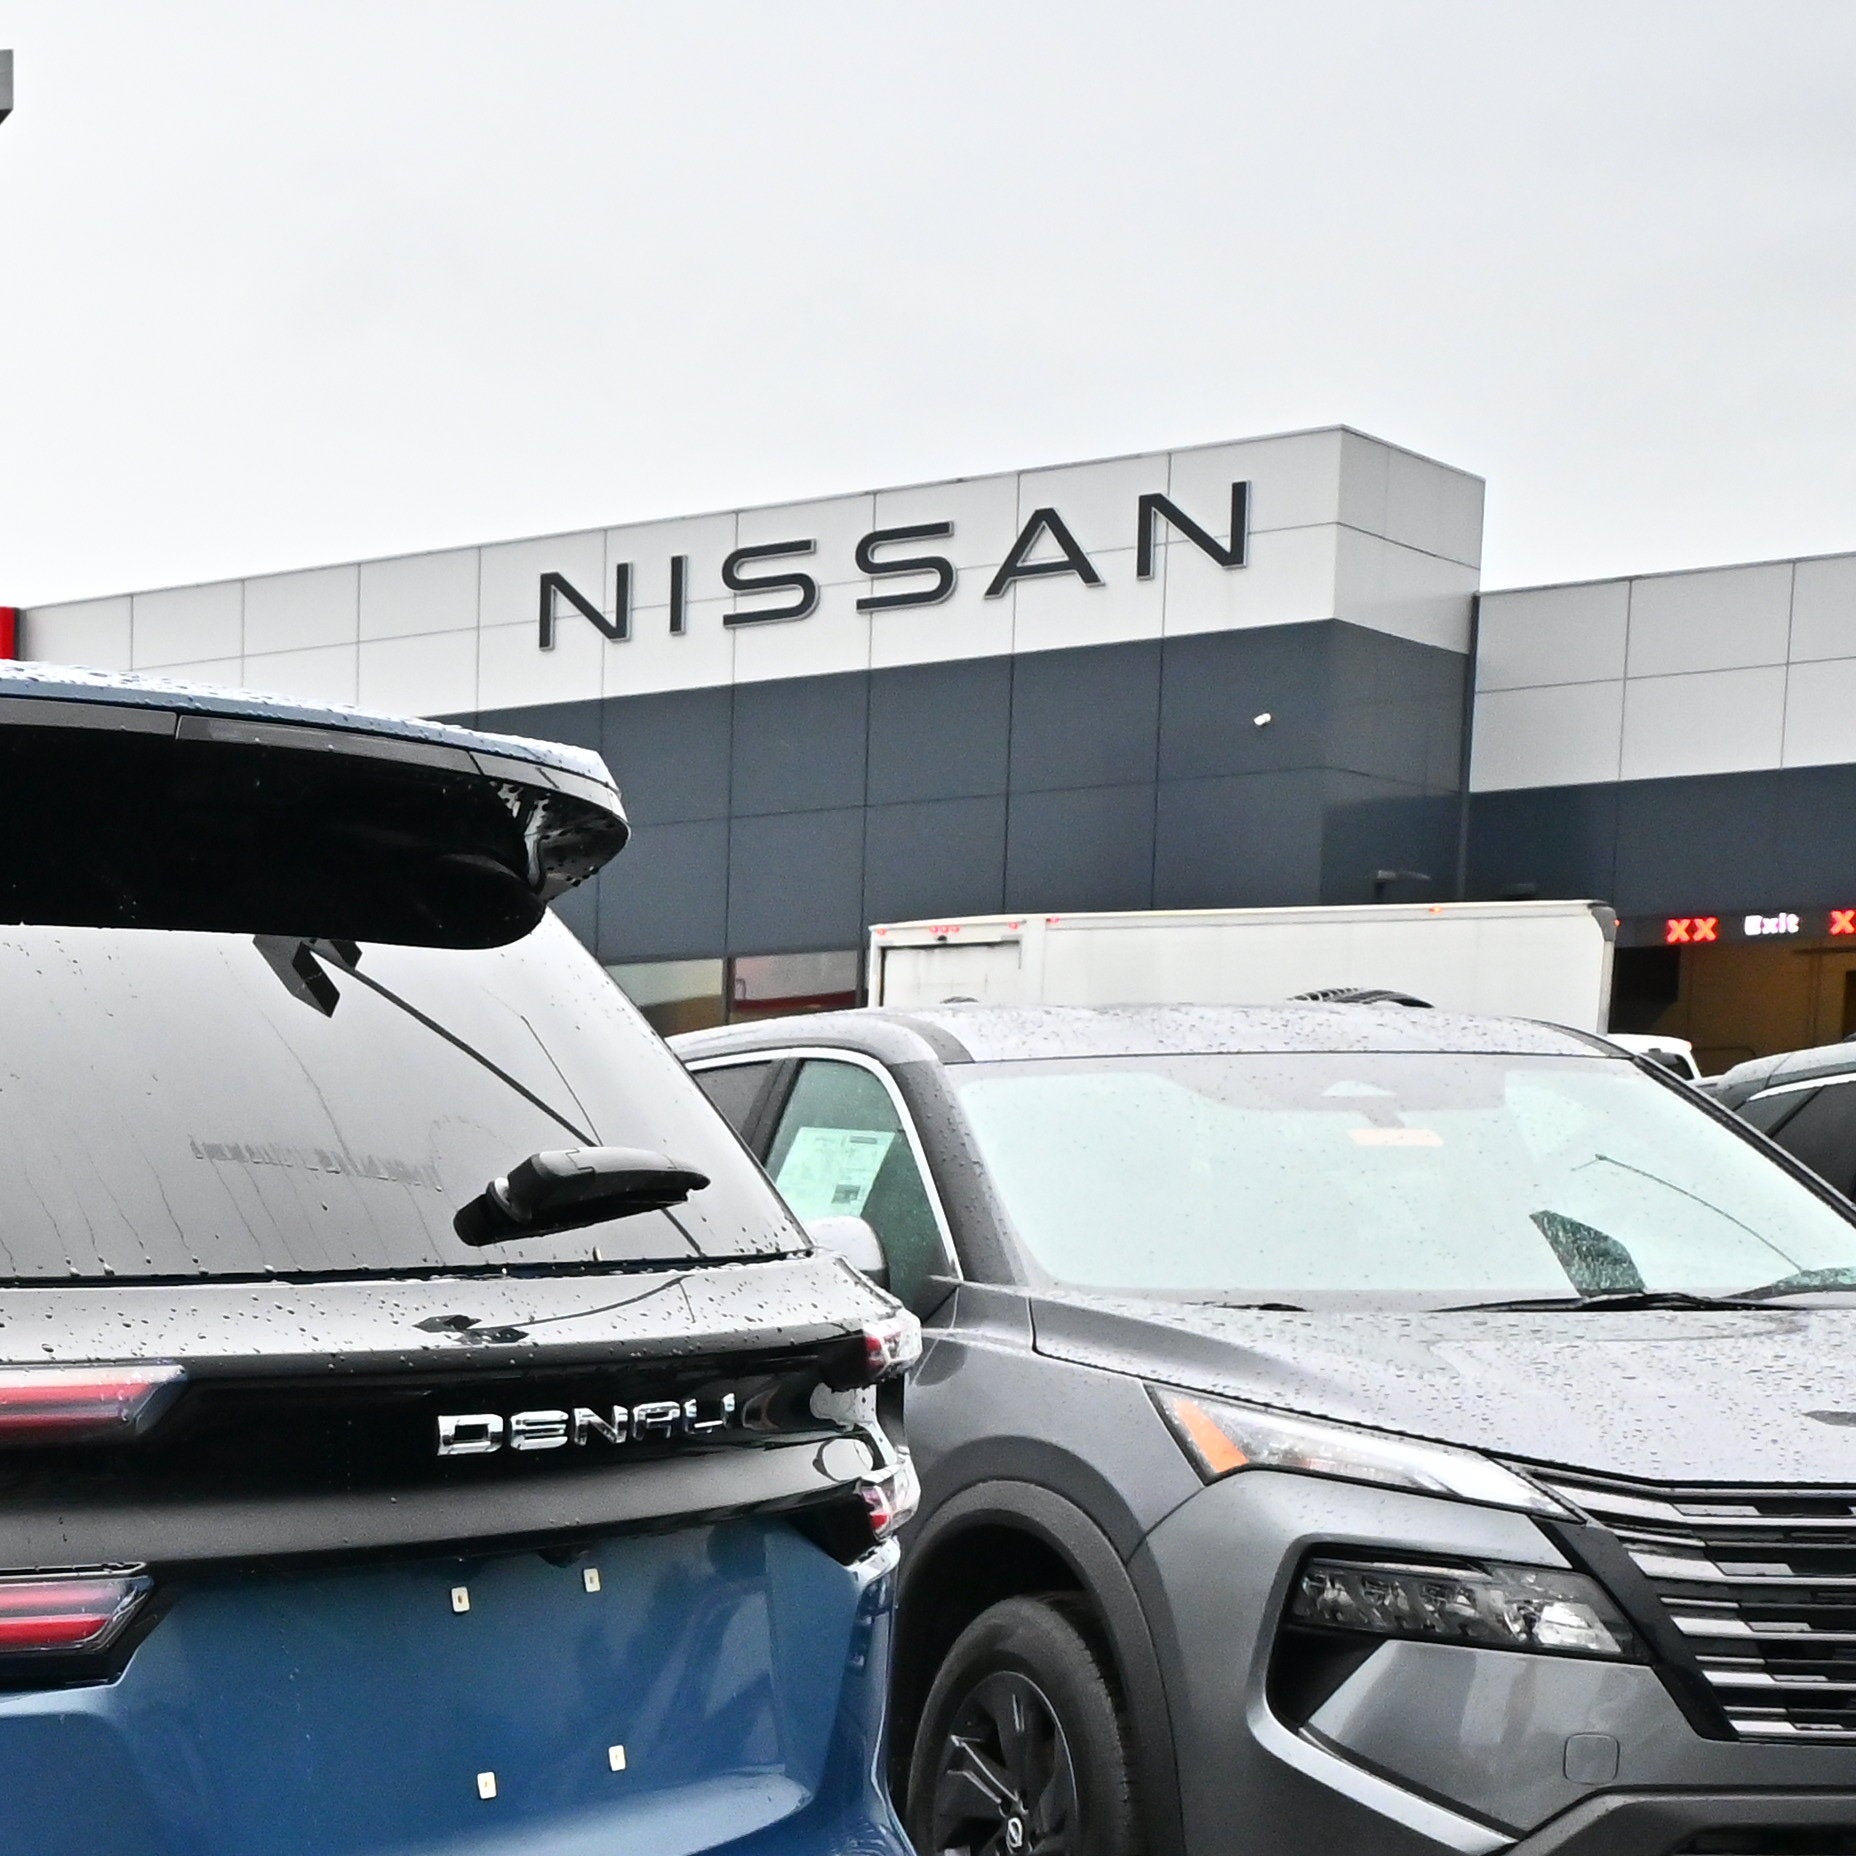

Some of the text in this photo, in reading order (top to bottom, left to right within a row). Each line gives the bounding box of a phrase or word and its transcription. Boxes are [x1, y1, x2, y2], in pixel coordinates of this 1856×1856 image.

[538, 480, 1252, 651] NISSAN
[1744, 902, 1799, 936] Exit
[436, 1393, 735, 1456] DENALI
